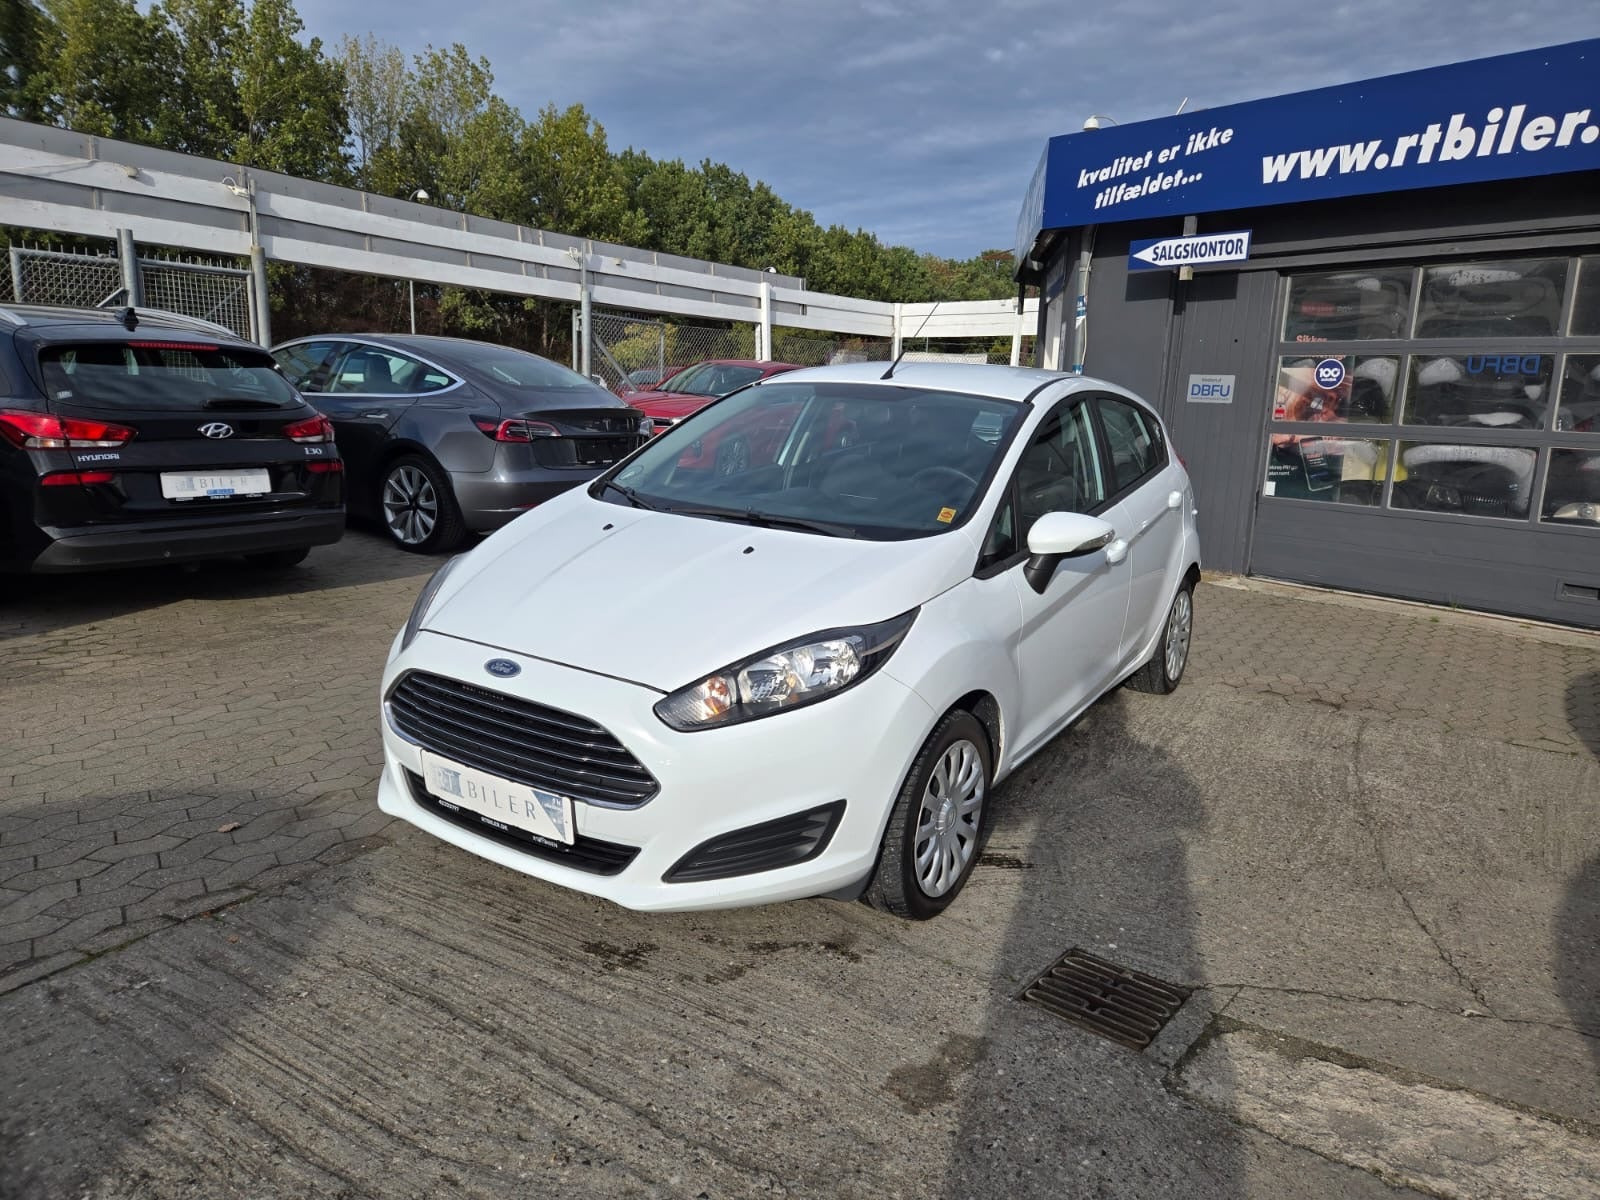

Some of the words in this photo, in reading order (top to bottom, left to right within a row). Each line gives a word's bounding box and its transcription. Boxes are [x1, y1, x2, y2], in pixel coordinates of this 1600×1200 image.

[1077, 150, 1153, 188] kvalitet
[1158, 144, 1180, 164] er
[1185, 127, 1234, 156] ikke
[1262, 104, 1600, 184] www.rtbiler.
[1094, 169, 1203, 209] tilfældet...
[1152, 238, 1244, 262] SALGSKONTOR
[1191, 384, 1230, 397] DBFU
[77, 453, 120, 462] HYUNDAI
[468, 781, 536, 820] BILER
